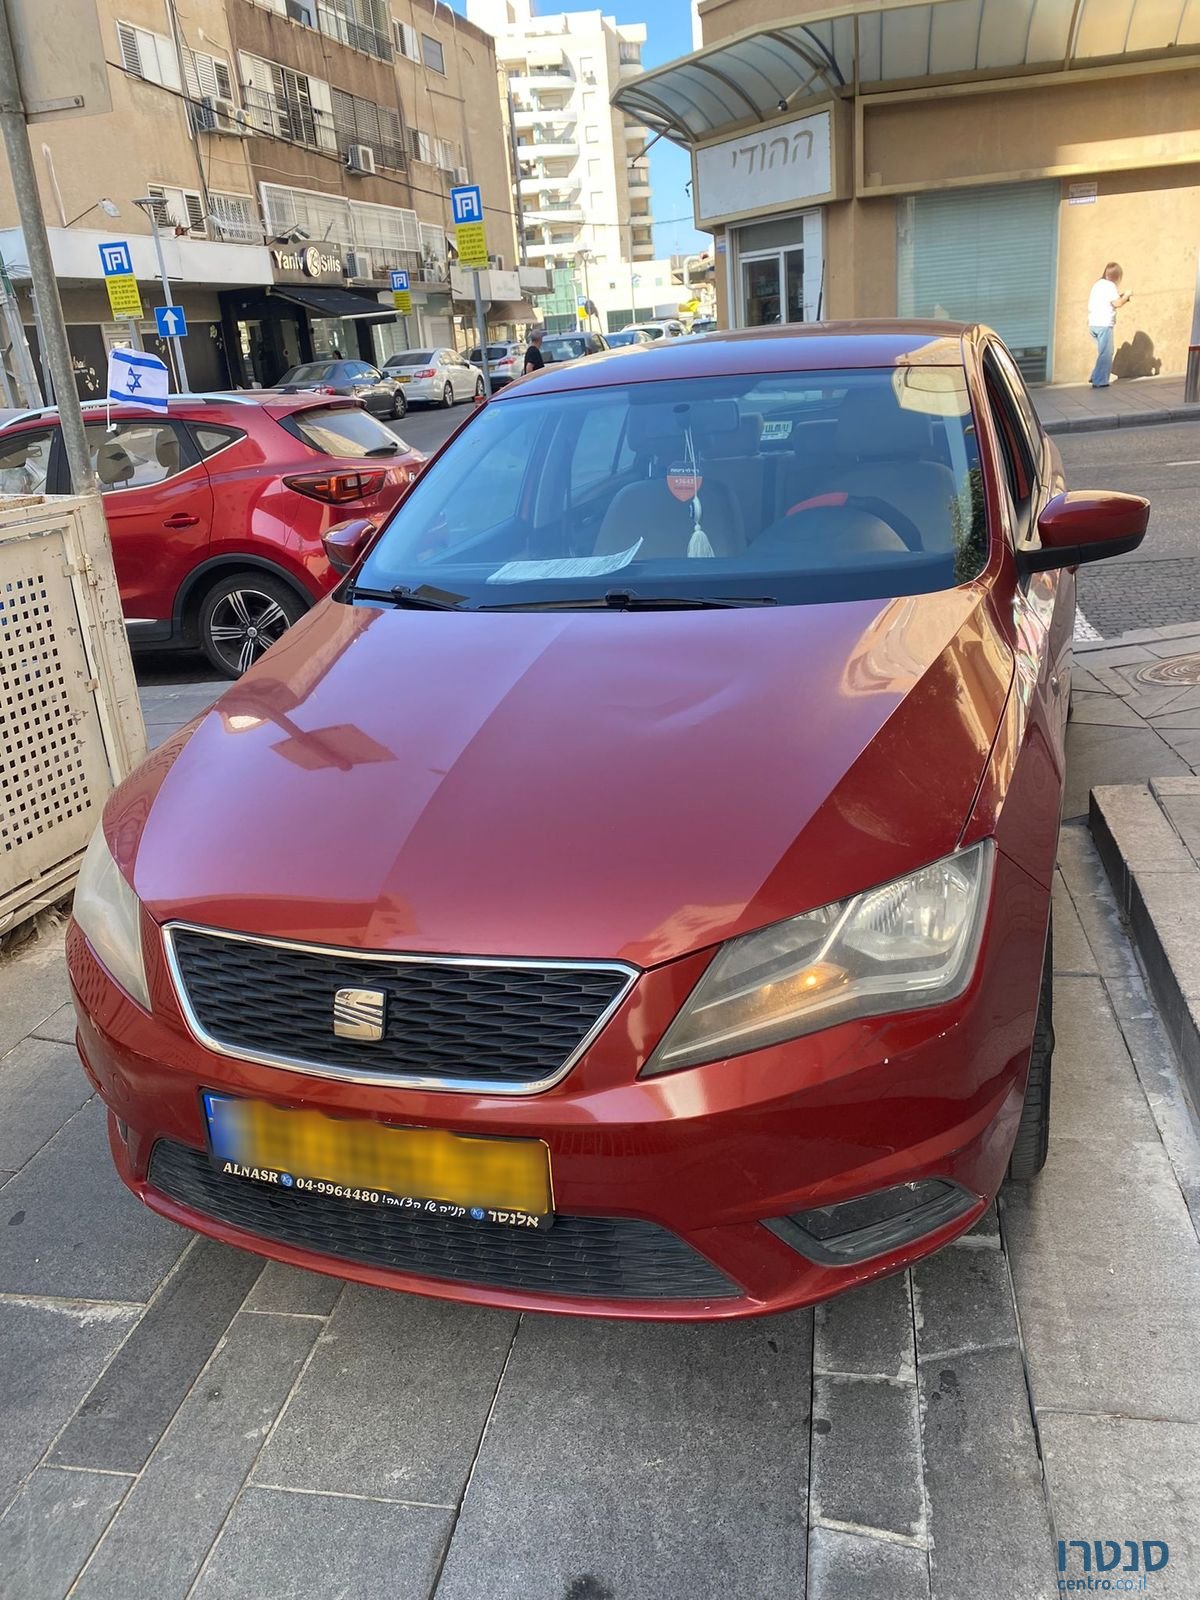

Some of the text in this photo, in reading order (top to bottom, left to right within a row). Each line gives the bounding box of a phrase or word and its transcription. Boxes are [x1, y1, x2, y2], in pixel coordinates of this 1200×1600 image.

[731, 130, 813, 175] ההודי
[274, 250, 341, 273] Yaniv Silis
[223, 1162, 279, 1184] ALNASR
[296, 1177, 379, 1203] 04-9964480
[424, 1200, 437, 1213] של
[439, 1205, 466, 1217] קנייה
[488, 1209, 540, 1229] אלנסר
